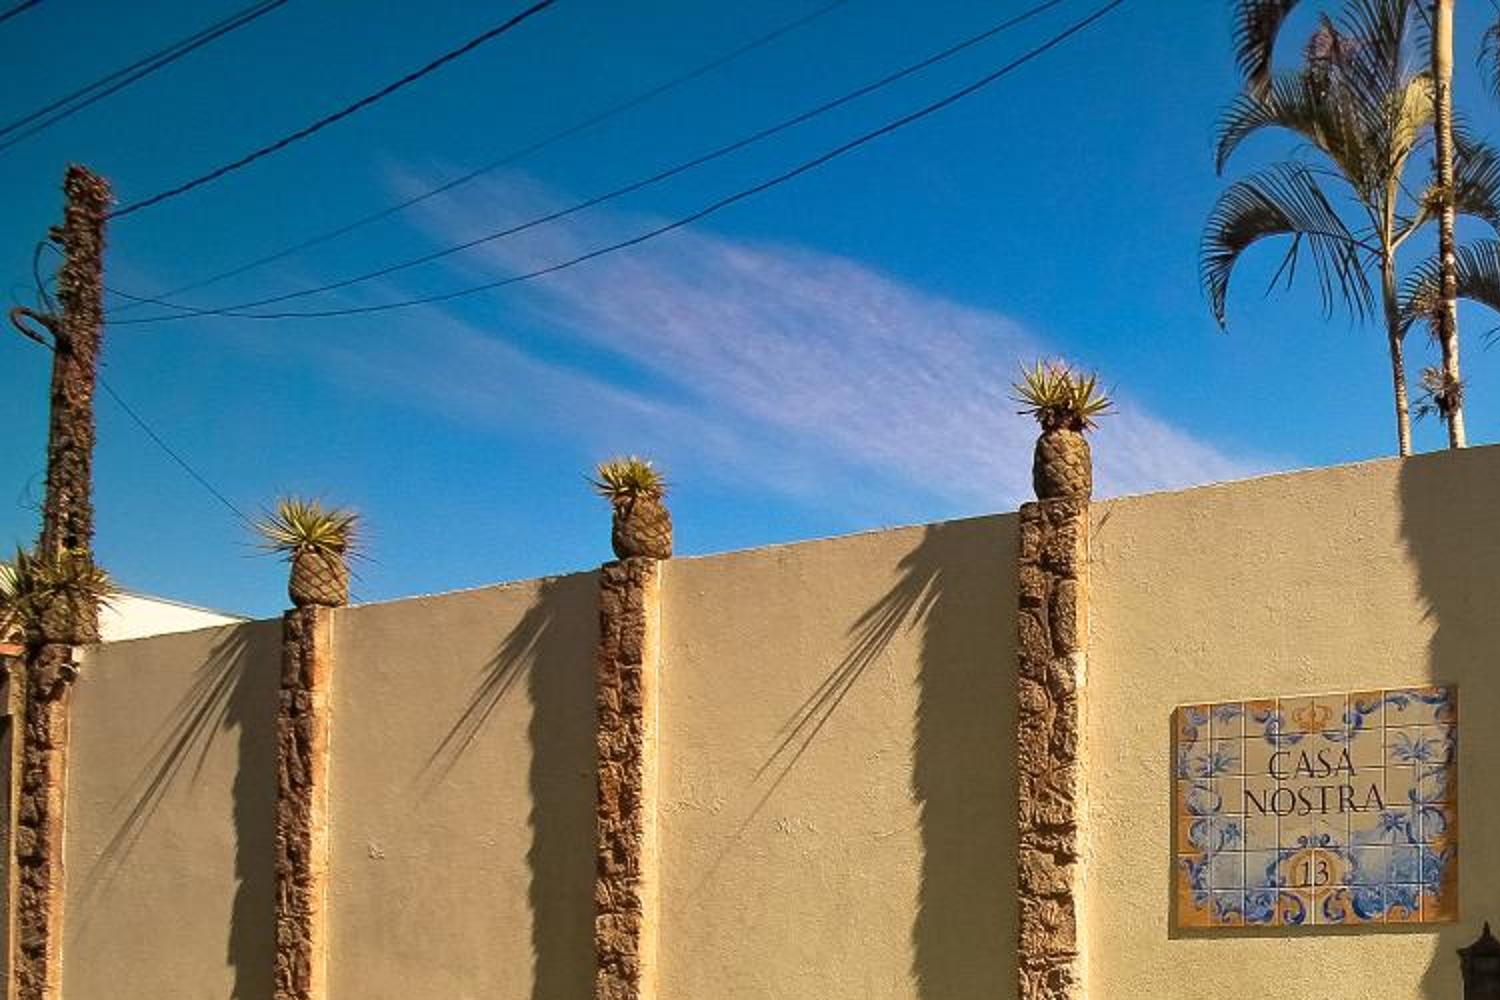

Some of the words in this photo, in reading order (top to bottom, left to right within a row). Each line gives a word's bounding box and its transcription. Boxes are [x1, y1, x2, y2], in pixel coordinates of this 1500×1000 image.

[1269, 748, 1357, 780] CASA
[1244, 784, 1385, 818] NOSTRA
[1300, 861, 1329, 888] 13
